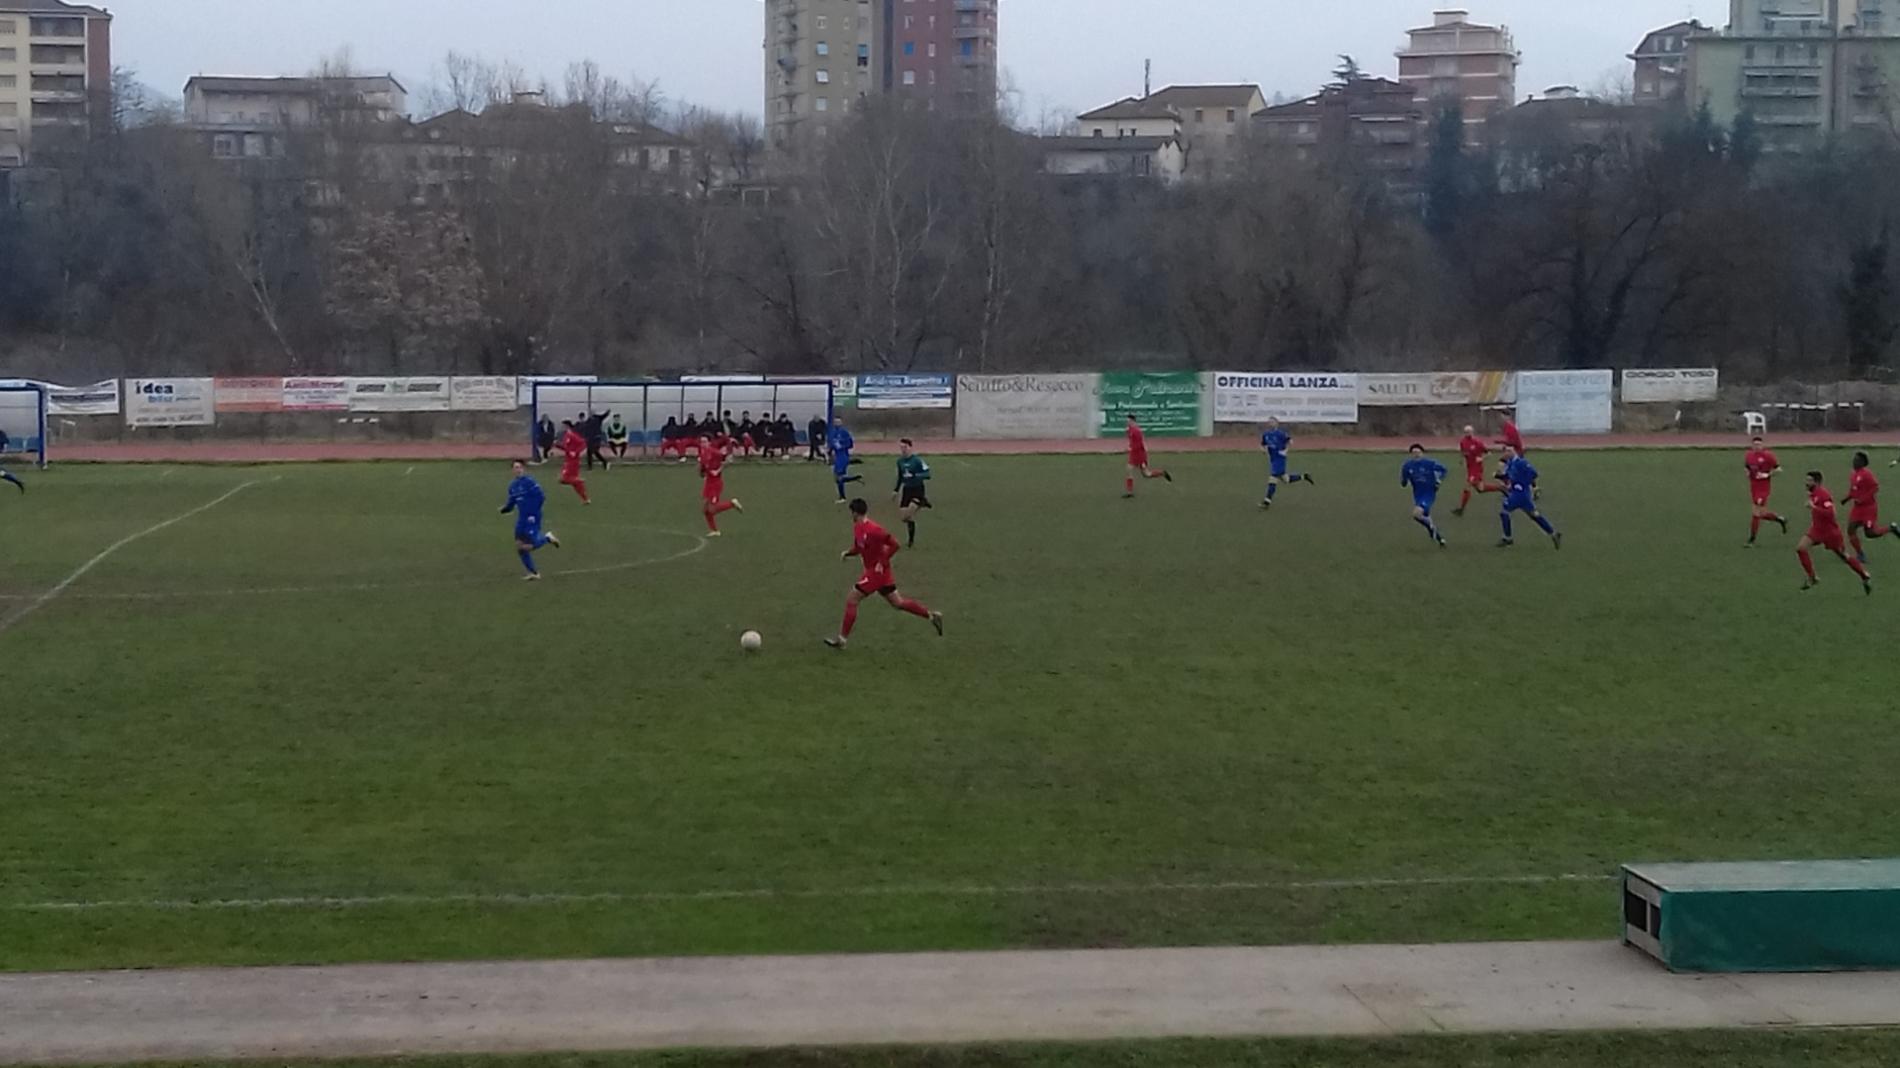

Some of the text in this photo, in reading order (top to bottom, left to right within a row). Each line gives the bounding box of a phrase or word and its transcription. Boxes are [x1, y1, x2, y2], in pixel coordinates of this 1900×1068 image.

[135, 381, 174, 395] idea
[1218, 376, 1285, 389] OFFICINA
[1289, 376, 1339, 389] LANZA
